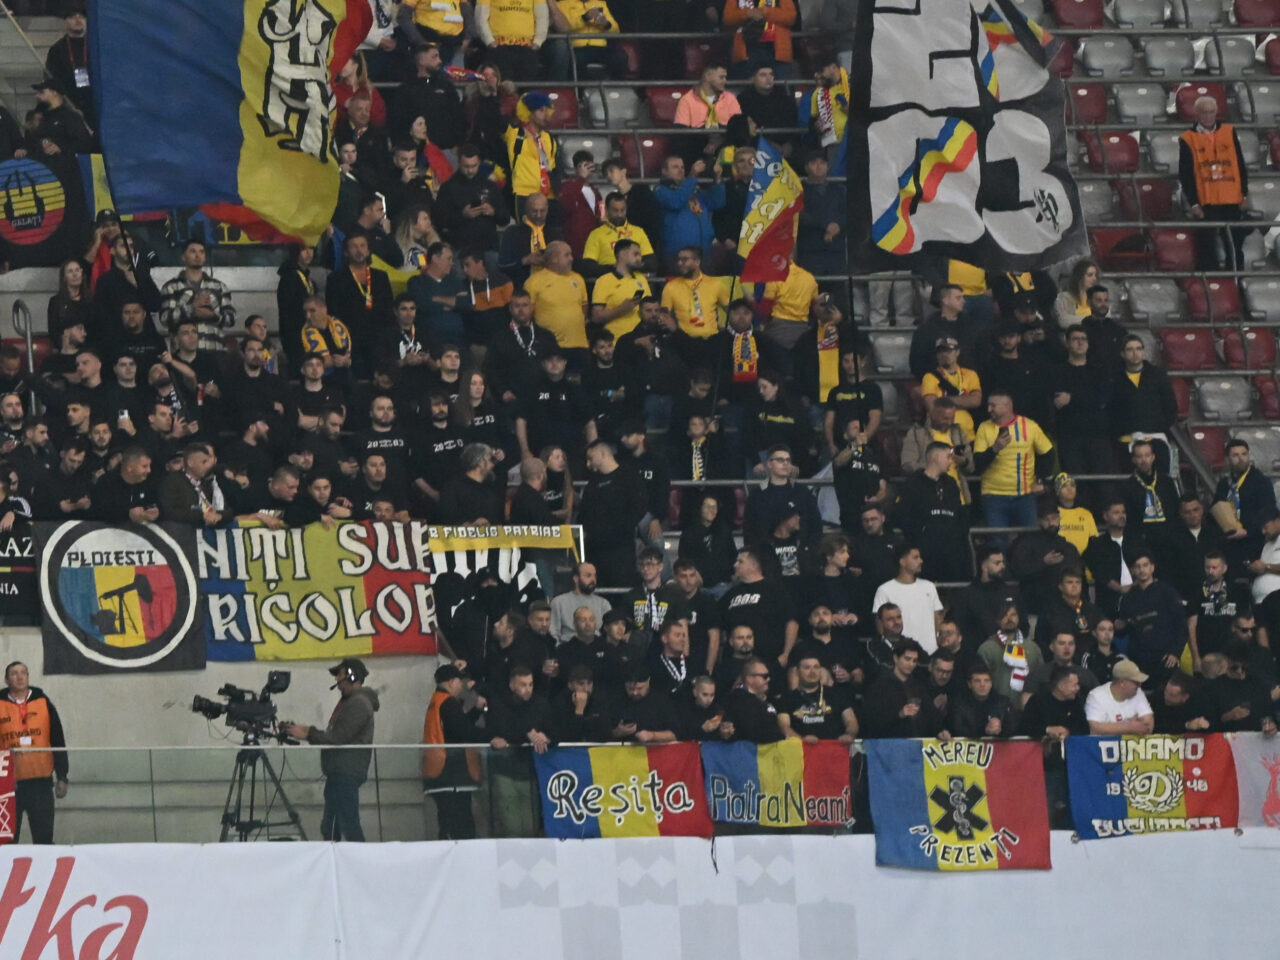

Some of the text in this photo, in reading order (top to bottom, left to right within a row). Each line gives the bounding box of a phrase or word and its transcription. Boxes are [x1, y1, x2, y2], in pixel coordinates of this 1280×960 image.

[443, 526, 498, 538] FIDELIS
[503, 524, 561, 538] PATRIAE
[196, 526, 307, 591] NIȚI
[207, 584, 437, 644] RICOLOR
[923, 741, 994, 770] MEREU
[1098, 737, 1205, 762] DINAMO
[547, 769, 695, 826] Reșița
[709, 774, 782, 823] Piatra
[909, 824, 1021, 865] PREZENȚI
